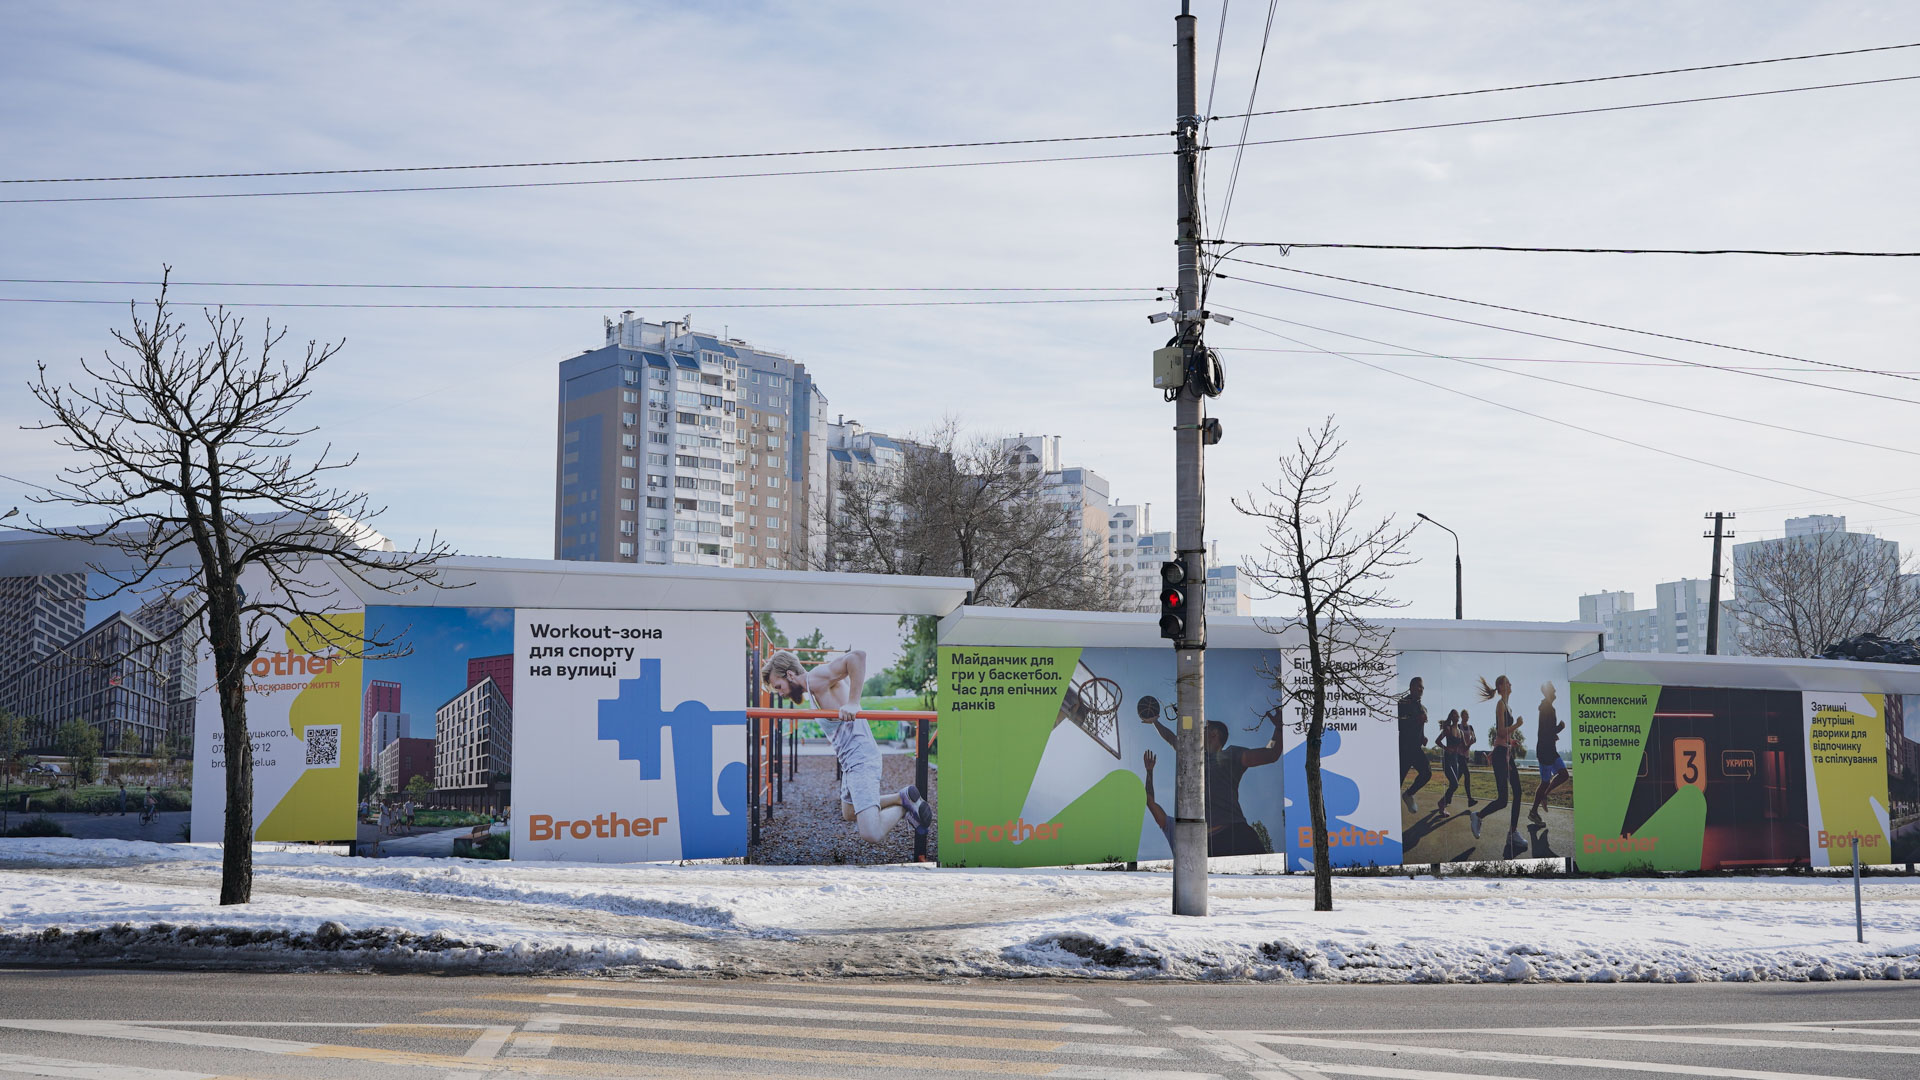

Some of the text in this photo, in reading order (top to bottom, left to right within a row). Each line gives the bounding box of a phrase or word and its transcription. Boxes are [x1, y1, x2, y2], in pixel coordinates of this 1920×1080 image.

[530, 623, 663, 639] Workout-зона
[529, 646, 634, 662] для спорту
[951, 652, 1054, 667] Майданчик для
[216, 648, 341, 678] other
[530, 661, 617, 680] на вулиці
[951, 668, 1062, 683] гри у баскетбол.
[310, 681, 340, 689] життя
[951, 683, 1058, 696] Час для епічних
[951, 698, 996, 711] данків
[1577, 693, 1648, 705] Комплексний
[1294, 706, 1367, 718] треування
[1811, 701, 1847, 712] Затишні
[1578, 710, 1616, 719] захист:
[1811, 714, 1855, 727] внутрішні
[1295, 722, 1358, 735] з дузями
[1578, 721, 1641, 734] відеонагляд
[212, 732, 227, 741] ву
[1812, 729, 1867, 740] дворики для
[1579, 735, 1640, 748] та підземне
[1813, 740, 1862, 753] відпочинку
[212, 745, 226, 754] 07
[262, 743, 271, 752] 12
[1580, 752, 1621, 764] укриття
[1725, 759, 1753, 768] УКРИТТЯ
[1813, 753, 1878, 766] та спілкування
[1682, 750, 1699, 784] 3
[529, 811, 668, 841] Brother
[953, 817, 1065, 844] Brother
[1298, 825, 1389, 848] Bother
[1583, 832, 1659, 854] Brother
[1817, 829, 1881, 849] Brother
